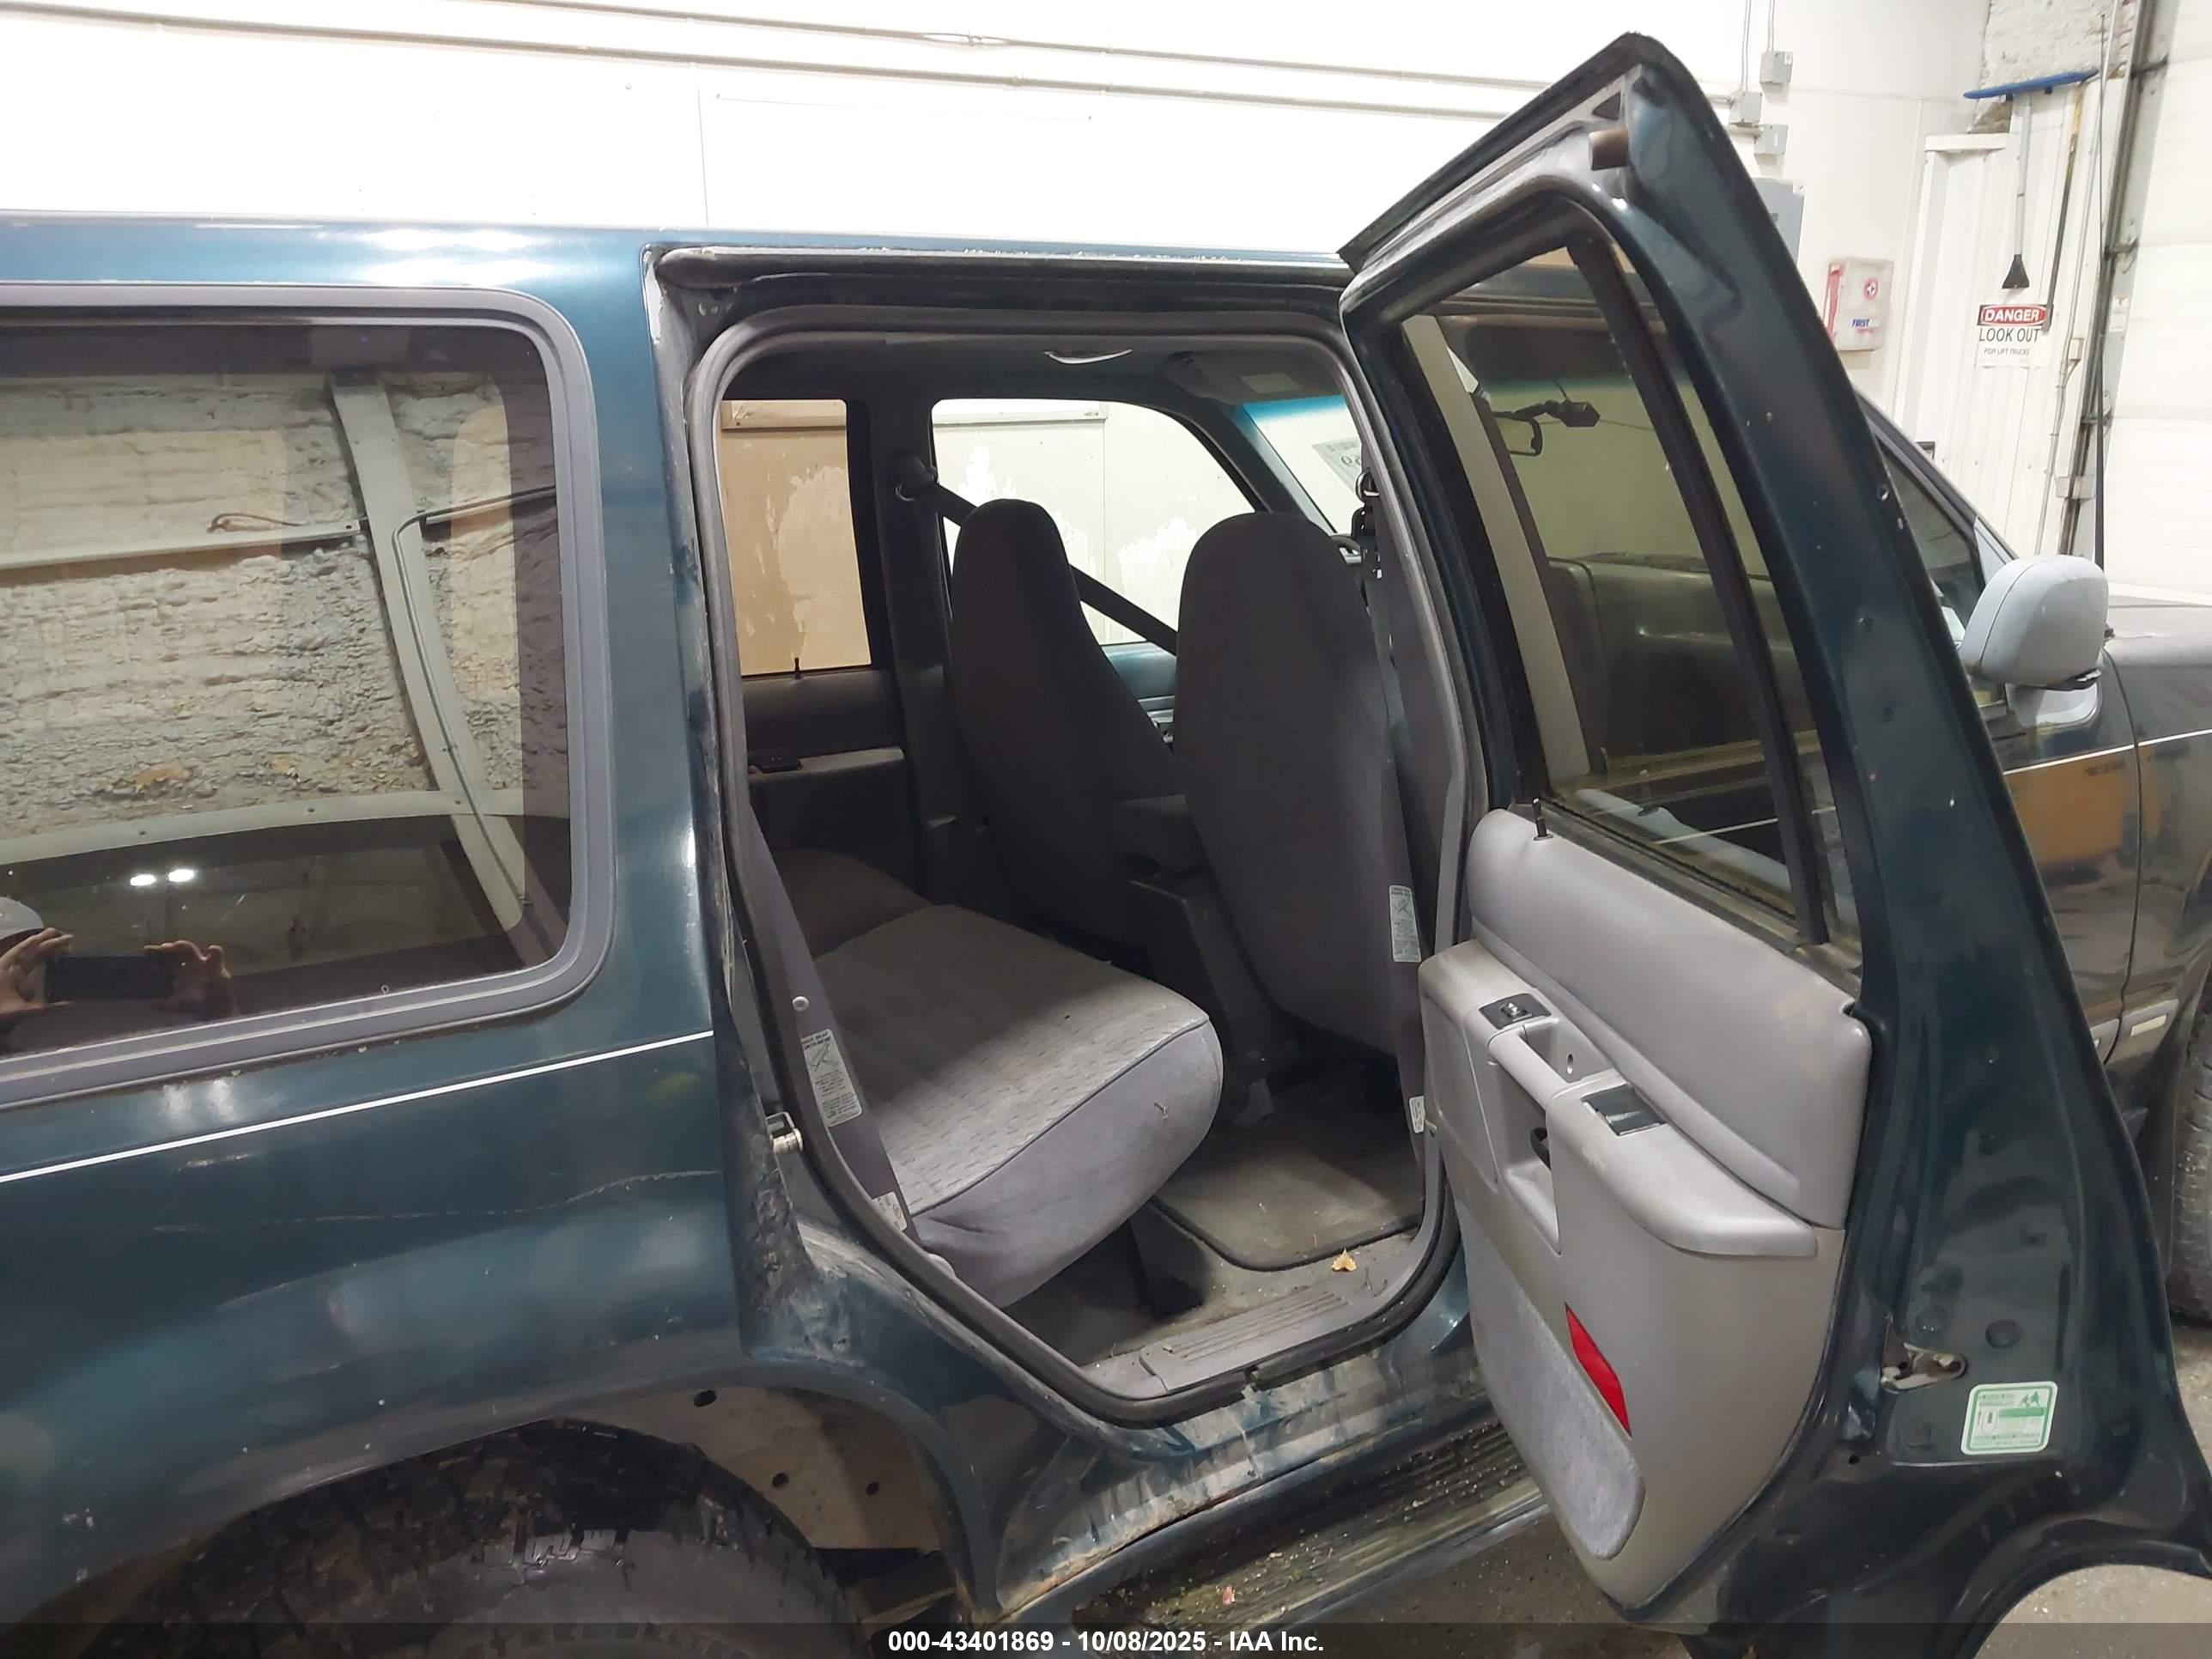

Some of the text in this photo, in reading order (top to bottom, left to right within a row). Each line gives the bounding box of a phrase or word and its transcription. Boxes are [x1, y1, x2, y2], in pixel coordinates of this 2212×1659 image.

[1984, 308, 2040, 322] DANGER
[1851, 319, 1870, 327] FIRST
[1978, 328, 2040, 343] LOOK OUT
[1984, 347, 2030, 356] FOR LIFT TRUCKS
